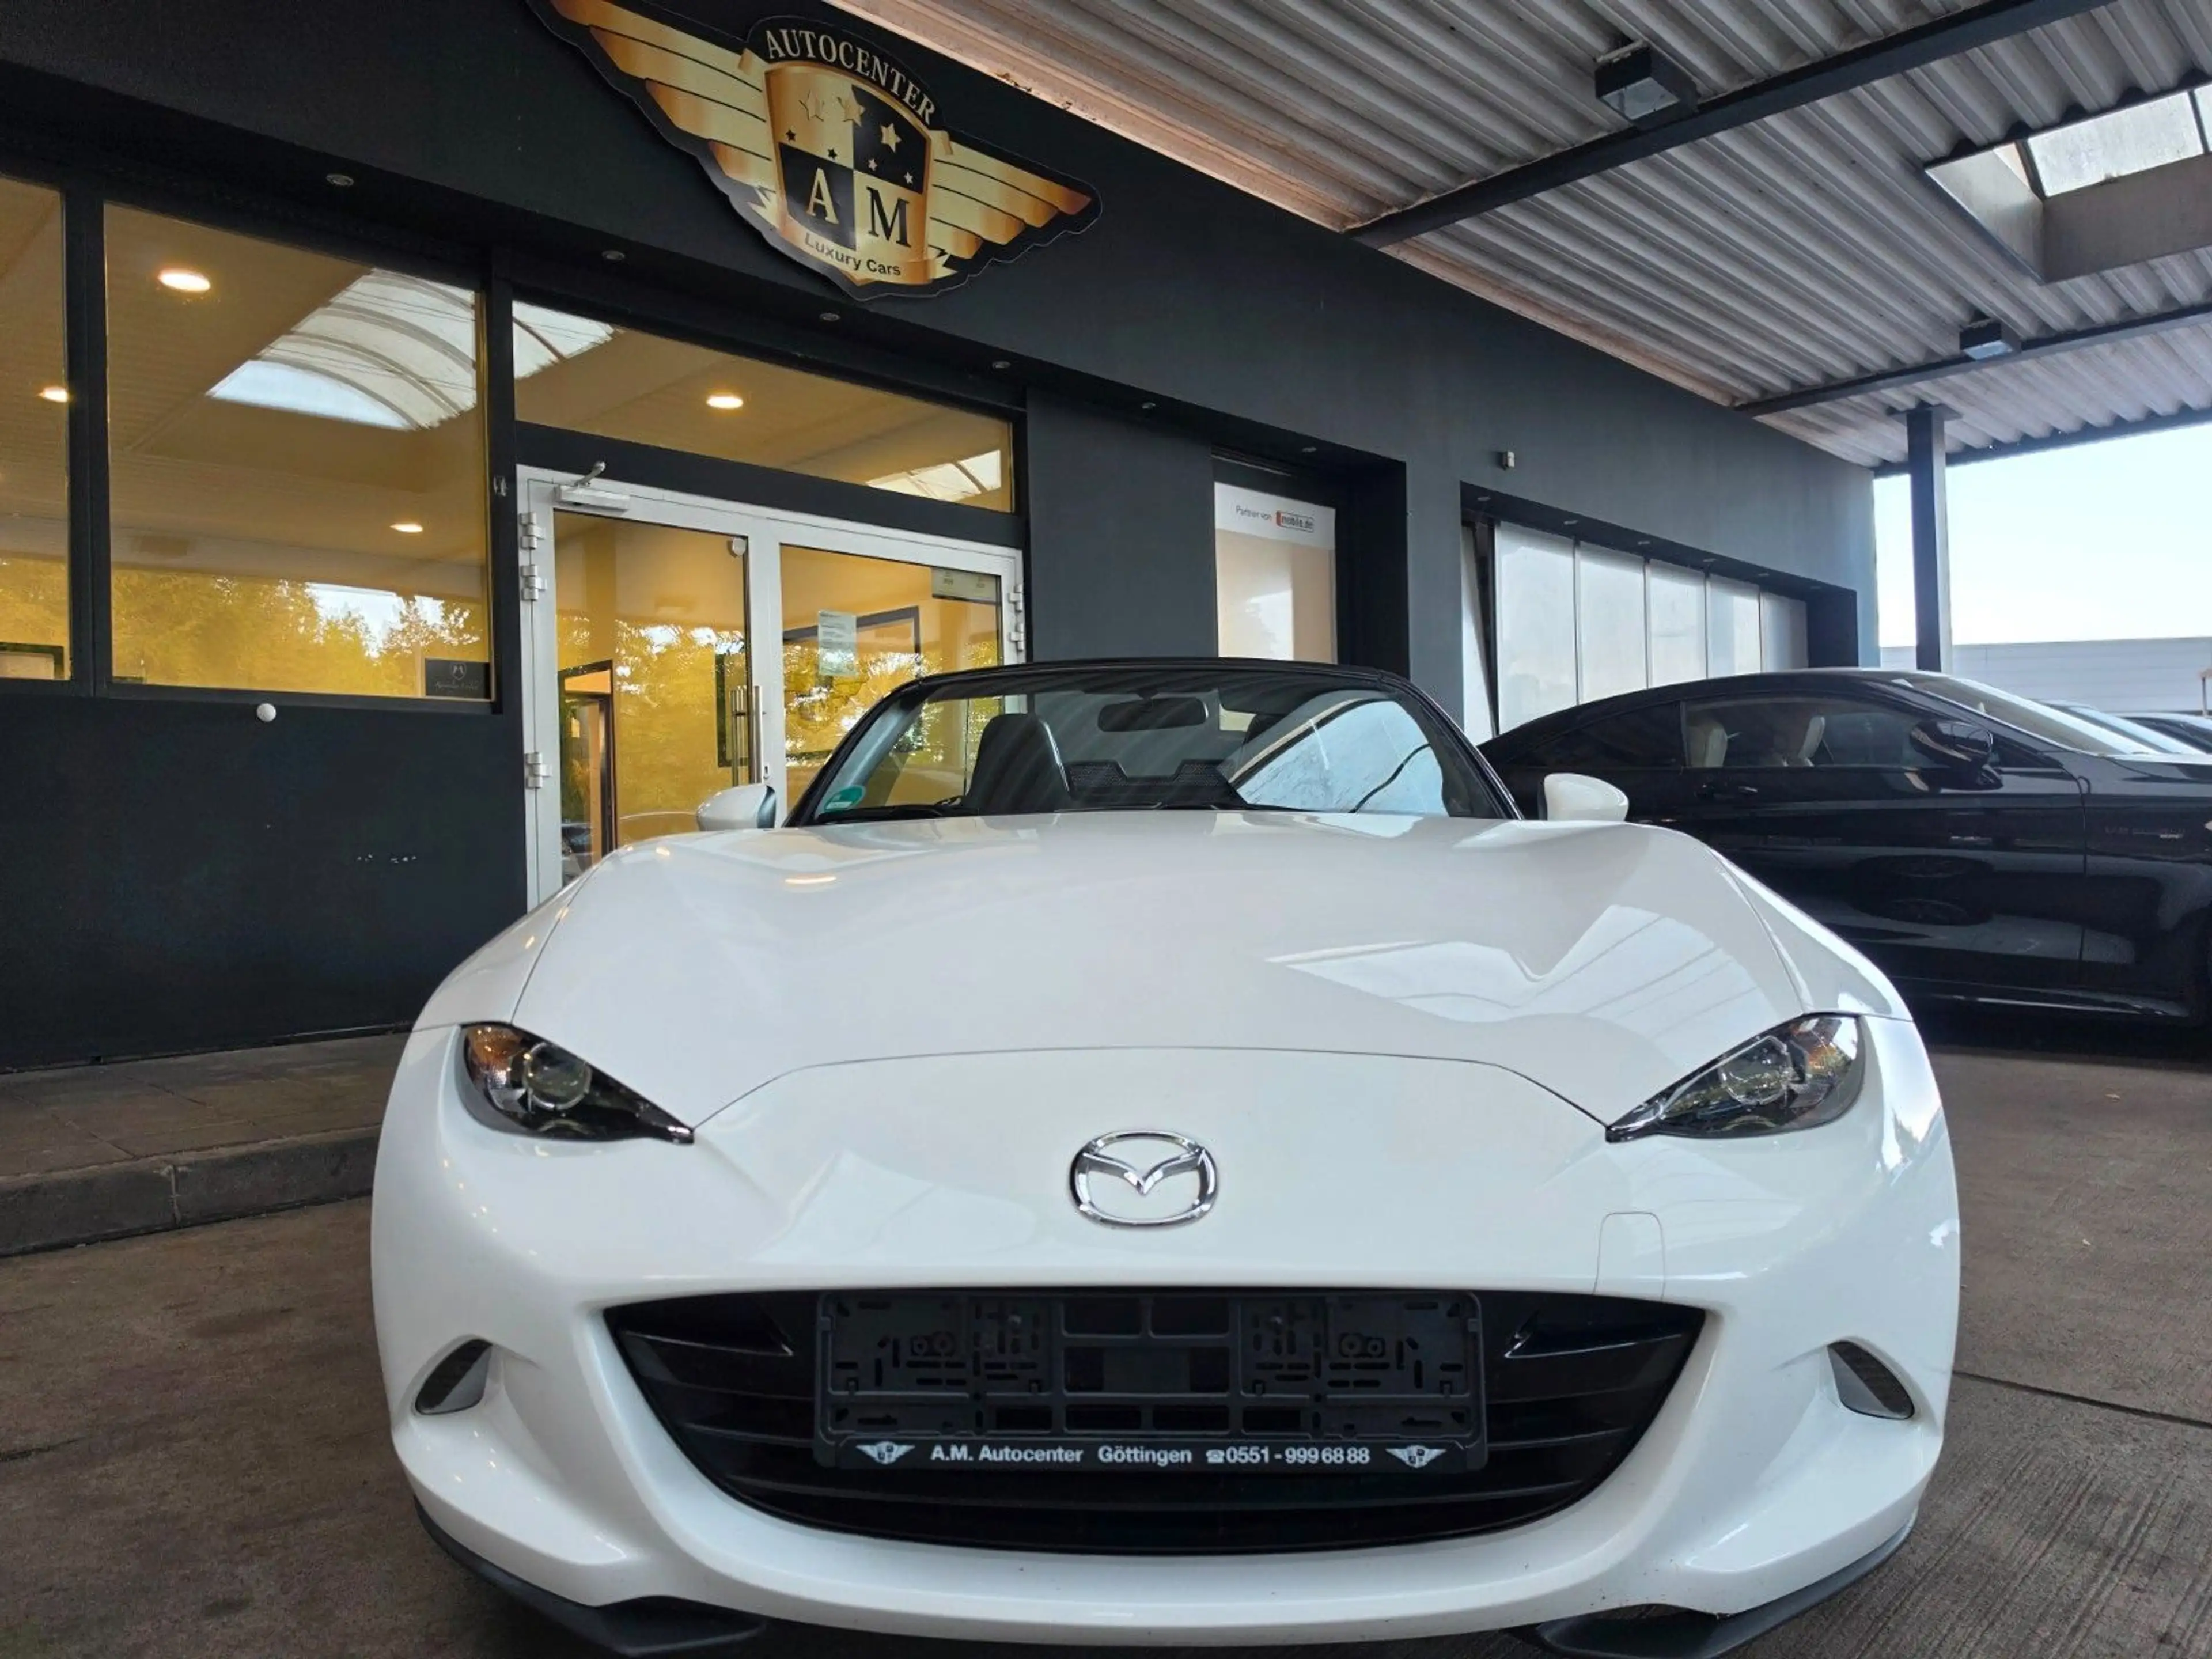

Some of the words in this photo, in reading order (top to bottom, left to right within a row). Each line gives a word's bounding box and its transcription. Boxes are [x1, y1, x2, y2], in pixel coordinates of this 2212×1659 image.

[765, 29, 935, 126] AUTOCENTER
[806, 168, 839, 224] A
[866, 187, 911, 248] M
[805, 232, 861, 271] Luxury
[866, 259, 901, 275] Cars
[930, 1445, 974, 1461] A.M.
[979, 1445, 1084, 1462] Autocenter
[1097, 1445, 1192, 1467] Göttingen
[1226, 1446, 1270, 1464] 0551
